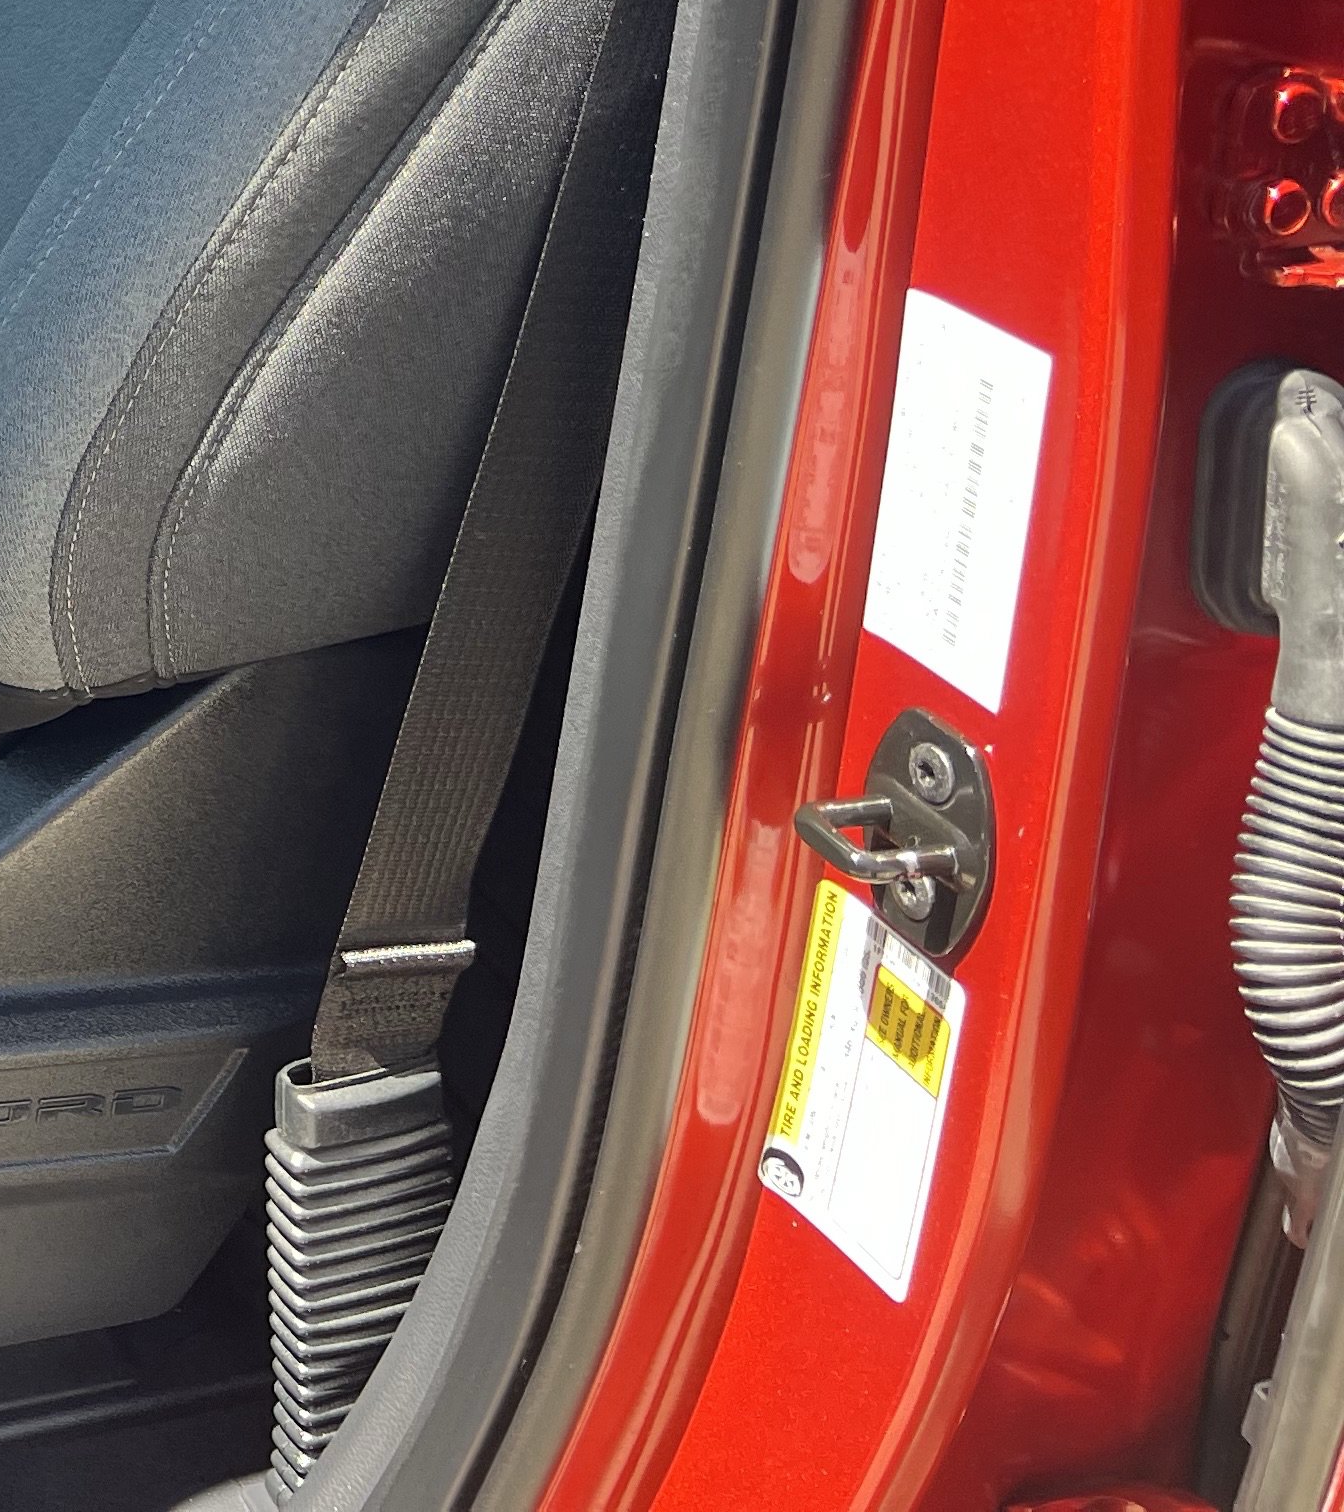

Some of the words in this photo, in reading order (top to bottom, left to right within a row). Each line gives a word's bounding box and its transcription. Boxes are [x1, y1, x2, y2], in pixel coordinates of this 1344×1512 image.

[780, 1104, 797, 1137] TIRE
[789, 1069, 804, 1101] AND
[797, 999, 817, 1068] LOADING
[812, 890, 838, 997] INFORMATION
